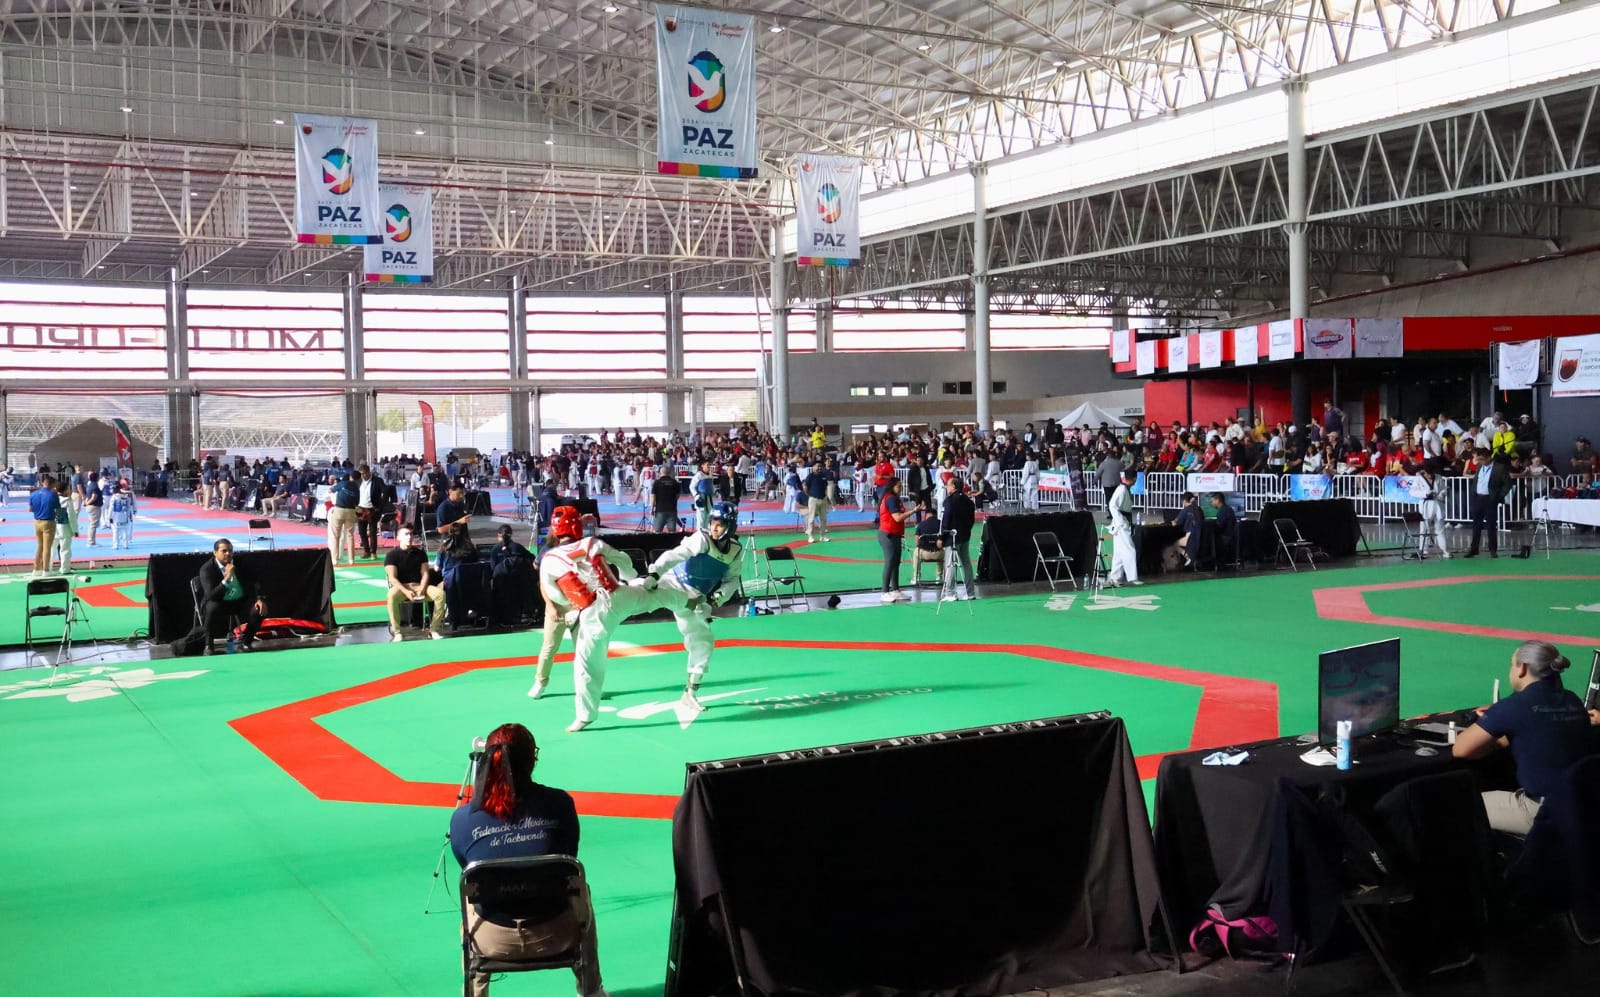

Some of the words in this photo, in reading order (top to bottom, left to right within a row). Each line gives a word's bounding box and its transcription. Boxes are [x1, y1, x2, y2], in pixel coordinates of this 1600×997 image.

[682, 126, 734, 149] PAZ
[683, 148, 735, 157] ZACATECAS
[318, 206, 361, 222] PAZ
[813, 233, 845, 247] PAZ
[382, 251, 417, 264] PAZ
[490, 837, 500, 847] de
